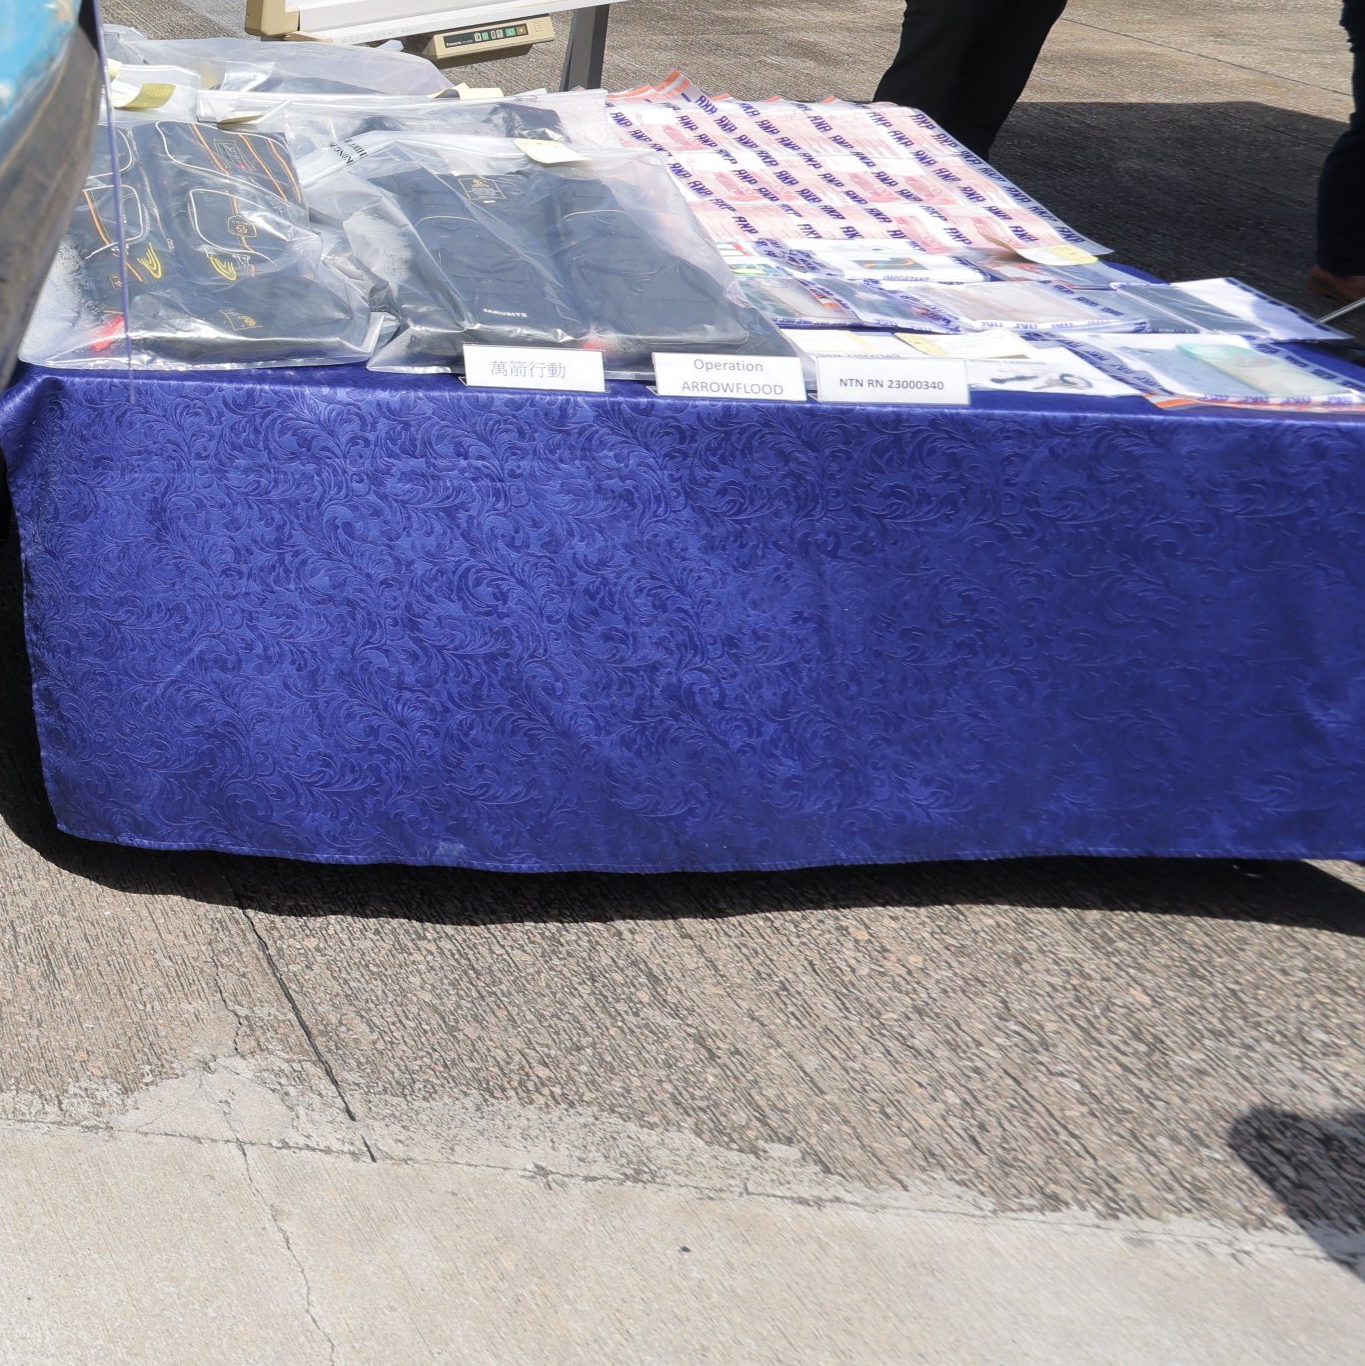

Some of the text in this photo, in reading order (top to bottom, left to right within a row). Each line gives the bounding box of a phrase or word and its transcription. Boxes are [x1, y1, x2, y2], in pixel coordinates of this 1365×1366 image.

[490, 359, 566, 379] 萬箭行動
[693, 358, 764, 373] Operation
[681, 380, 784, 396] ARROWFLOOD
[839, 378, 945, 391] NTN RN 23000340
